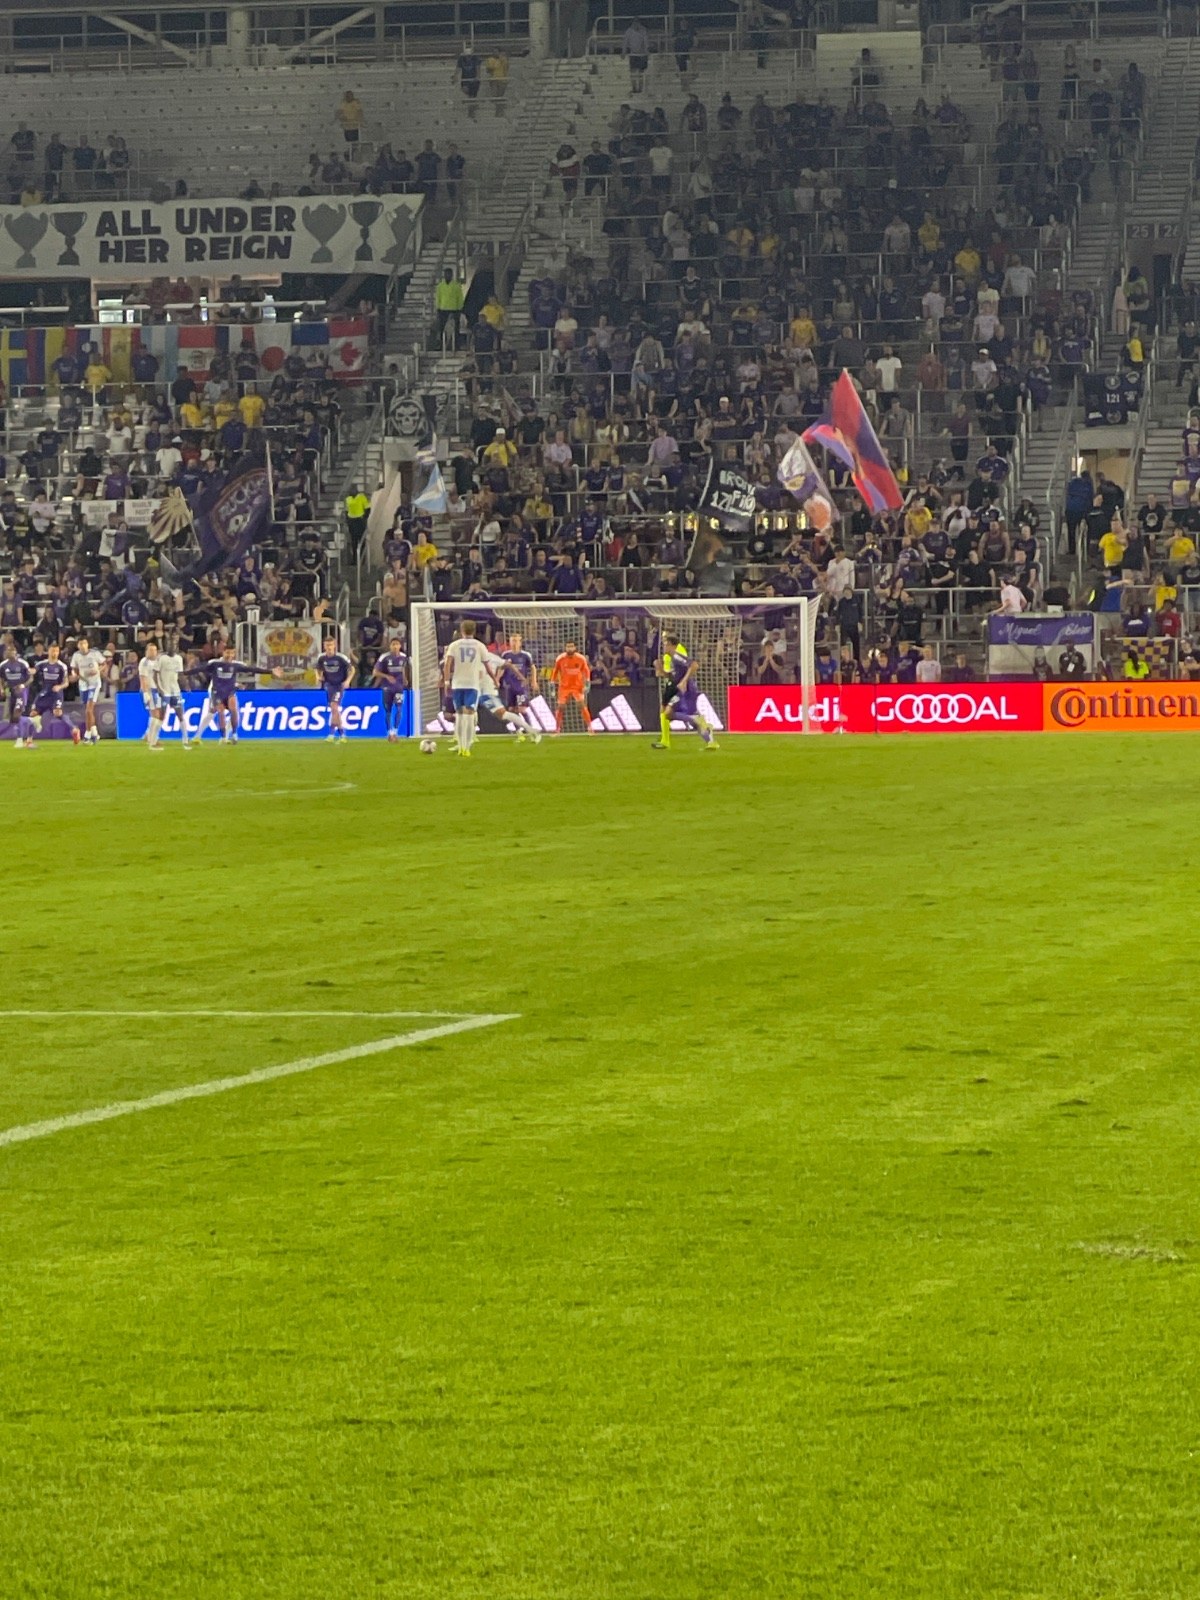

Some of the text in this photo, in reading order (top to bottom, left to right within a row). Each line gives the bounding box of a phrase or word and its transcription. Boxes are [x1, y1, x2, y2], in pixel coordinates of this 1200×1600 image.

[95, 205, 296, 237] ALL UNDER
[1131, 225, 1149, 238] 25
[99, 235, 292, 263] HER REIGN
[459, 647, 477, 663] 19
[754, 697, 840, 723] Audi
[1050, 687, 1200, 727] Continen
